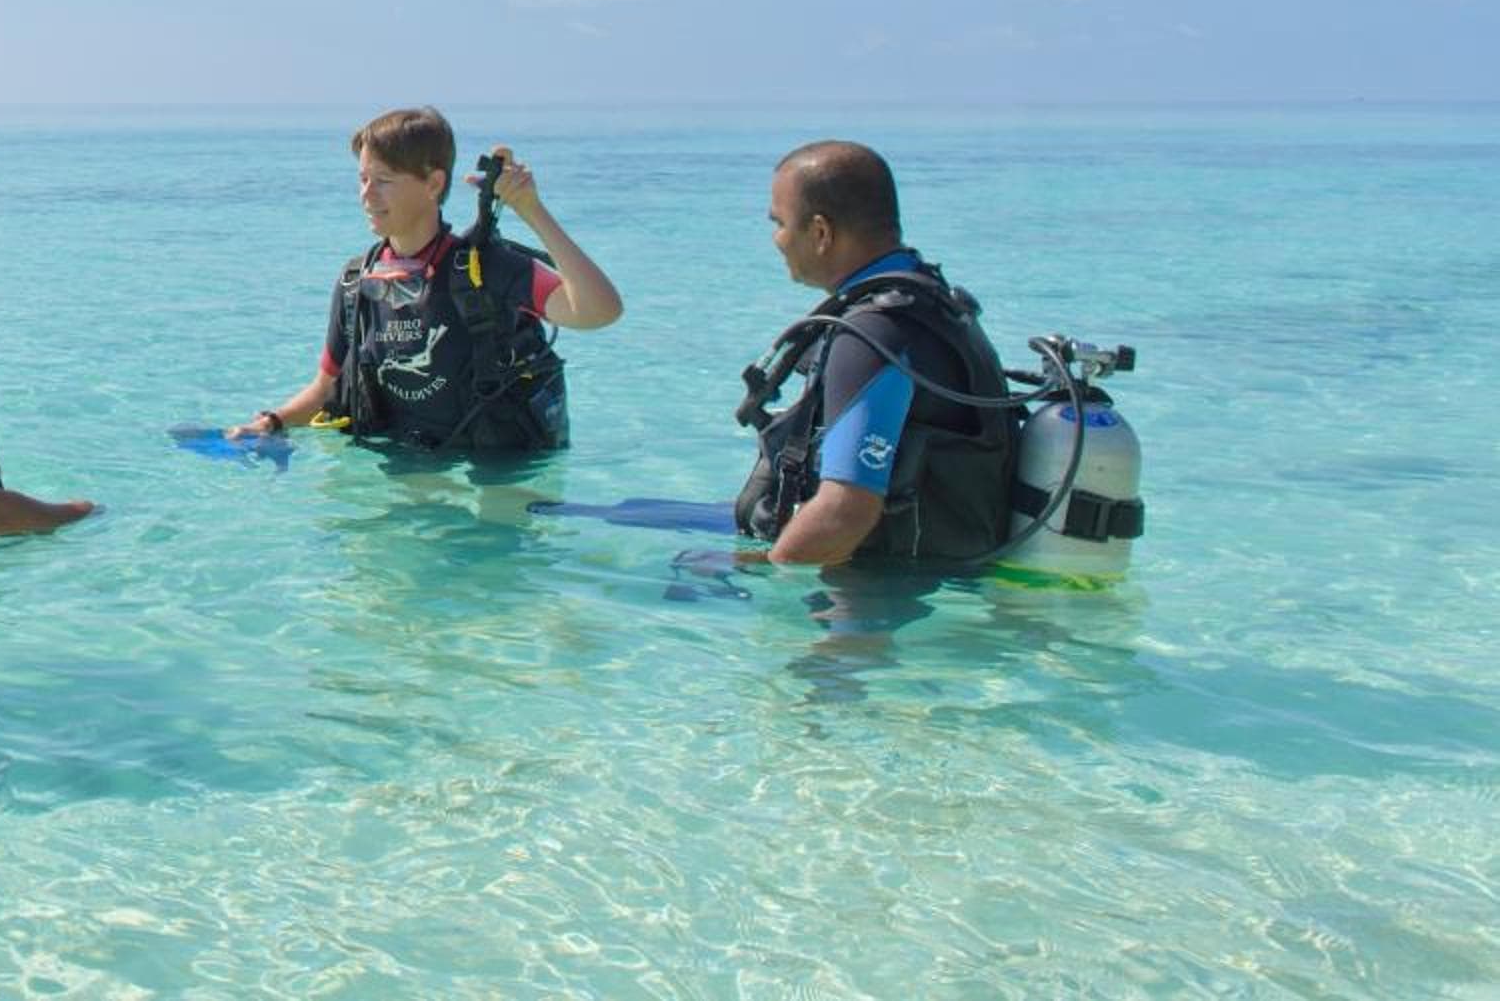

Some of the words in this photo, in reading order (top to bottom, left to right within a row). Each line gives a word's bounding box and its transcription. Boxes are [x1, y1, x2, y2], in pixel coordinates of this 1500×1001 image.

[387, 318, 421, 331] EURO
[375, 329, 423, 343] DIVERS
[386, 376, 448, 400] MALDIVES
